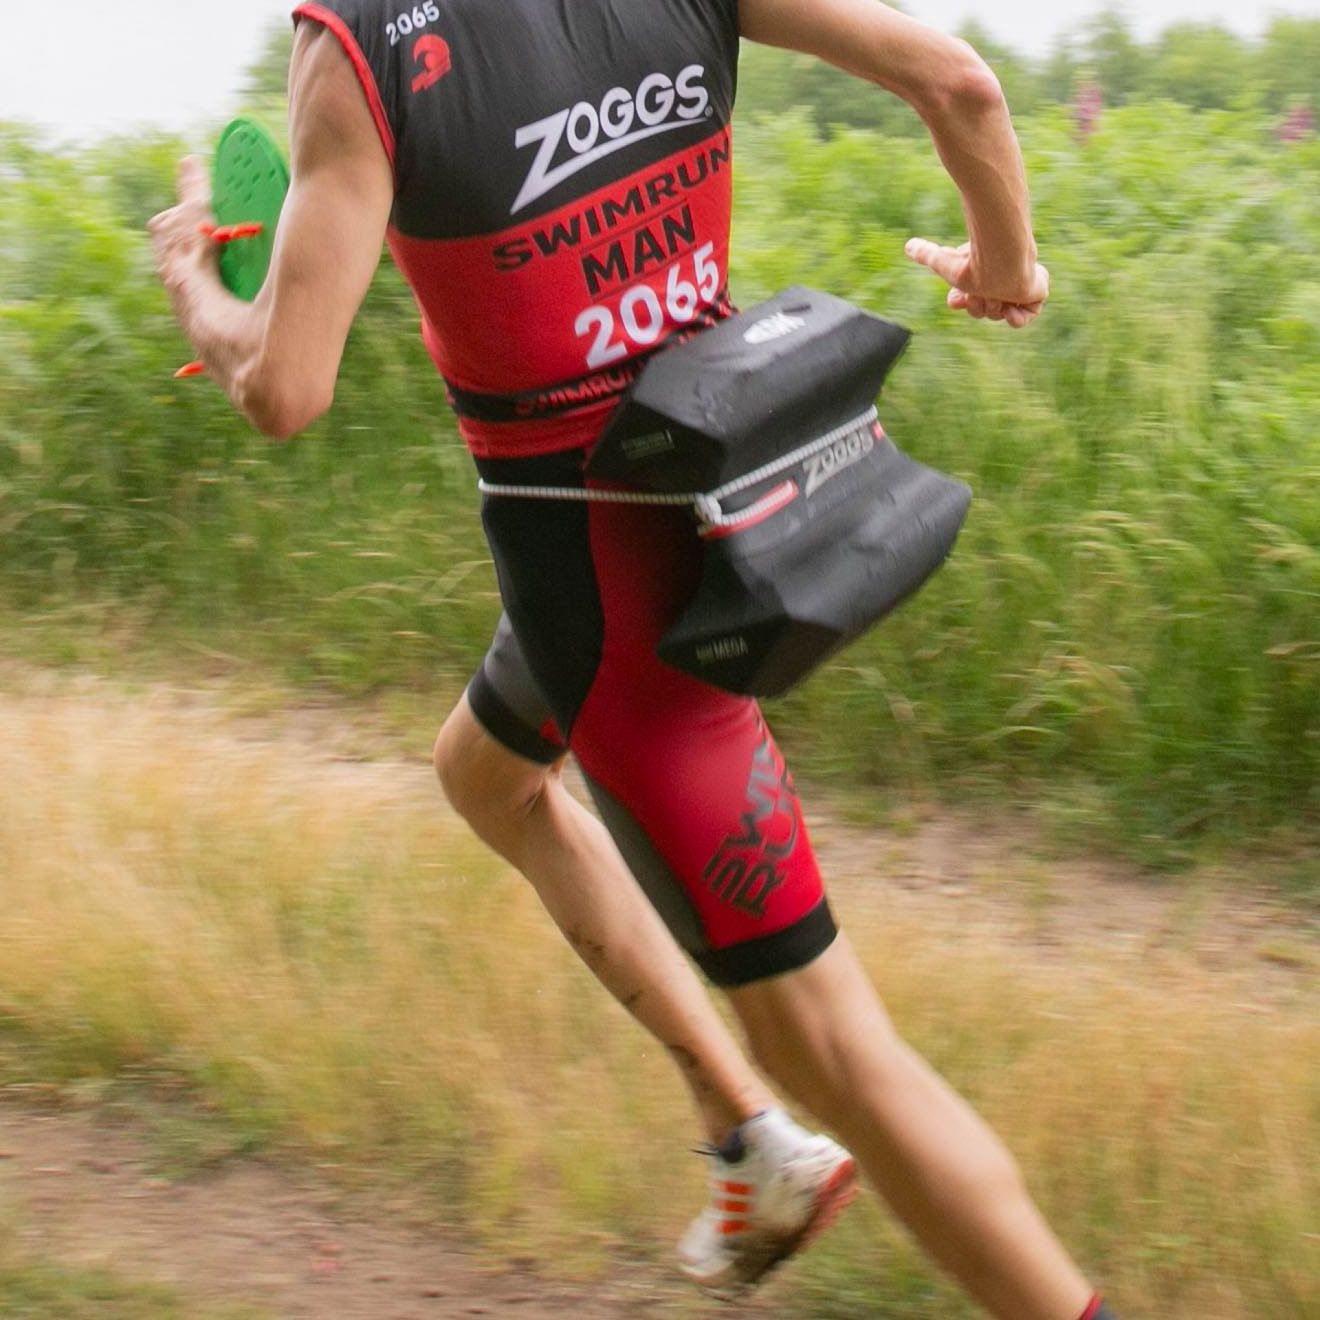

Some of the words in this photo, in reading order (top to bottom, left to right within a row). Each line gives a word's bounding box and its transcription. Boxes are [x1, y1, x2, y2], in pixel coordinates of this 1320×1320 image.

[385, 0, 440, 47] 2065
[510, 64, 709, 215] ZOGGS
[492, 137, 728, 272] SWIMRUN
[582, 206, 696, 296] MAN
[574, 241, 719, 370] 2065
